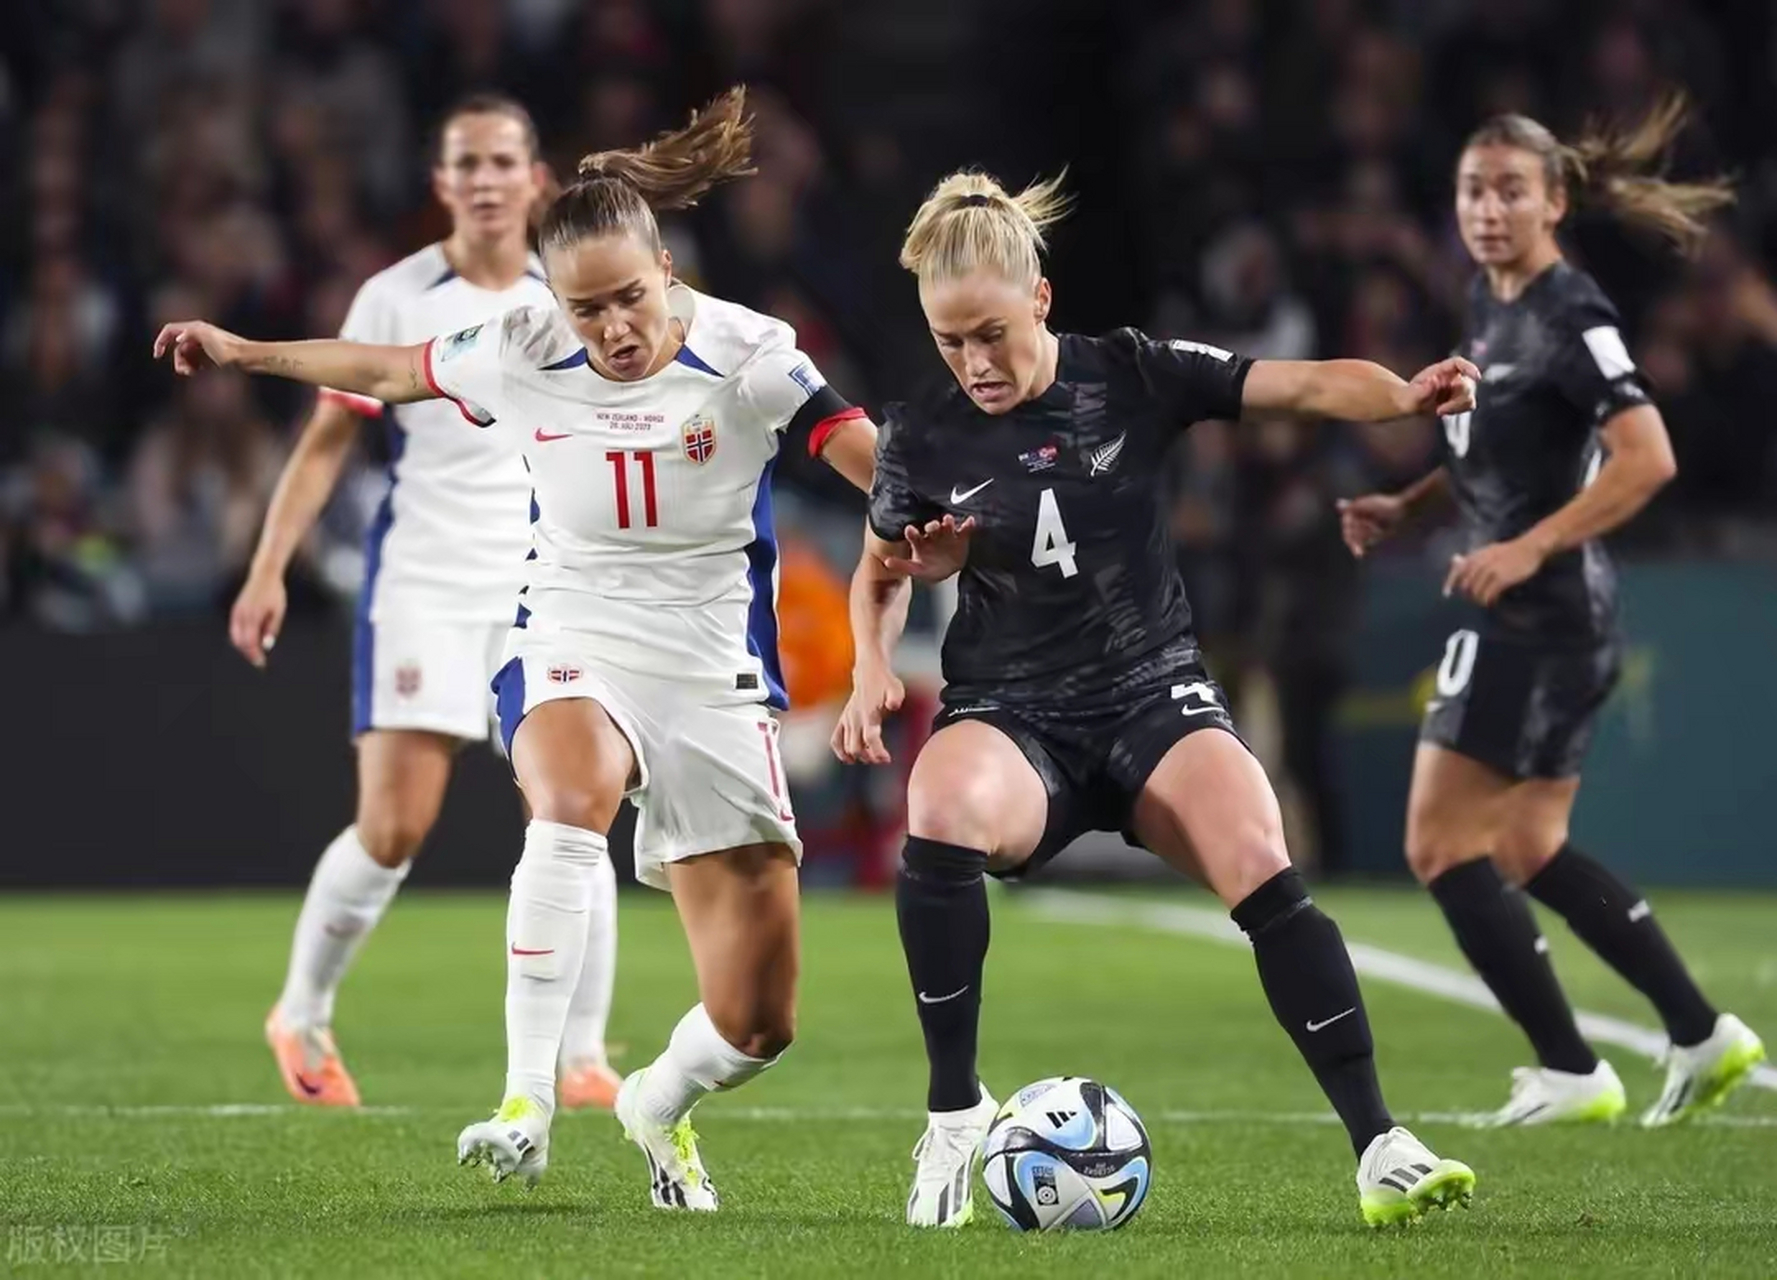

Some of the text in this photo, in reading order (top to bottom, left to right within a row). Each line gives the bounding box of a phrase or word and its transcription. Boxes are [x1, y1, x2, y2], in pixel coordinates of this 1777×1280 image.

[605, 450, 658, 529] 11
[1031, 488, 1079, 579] 4
[1437, 628, 1479, 697] 0
